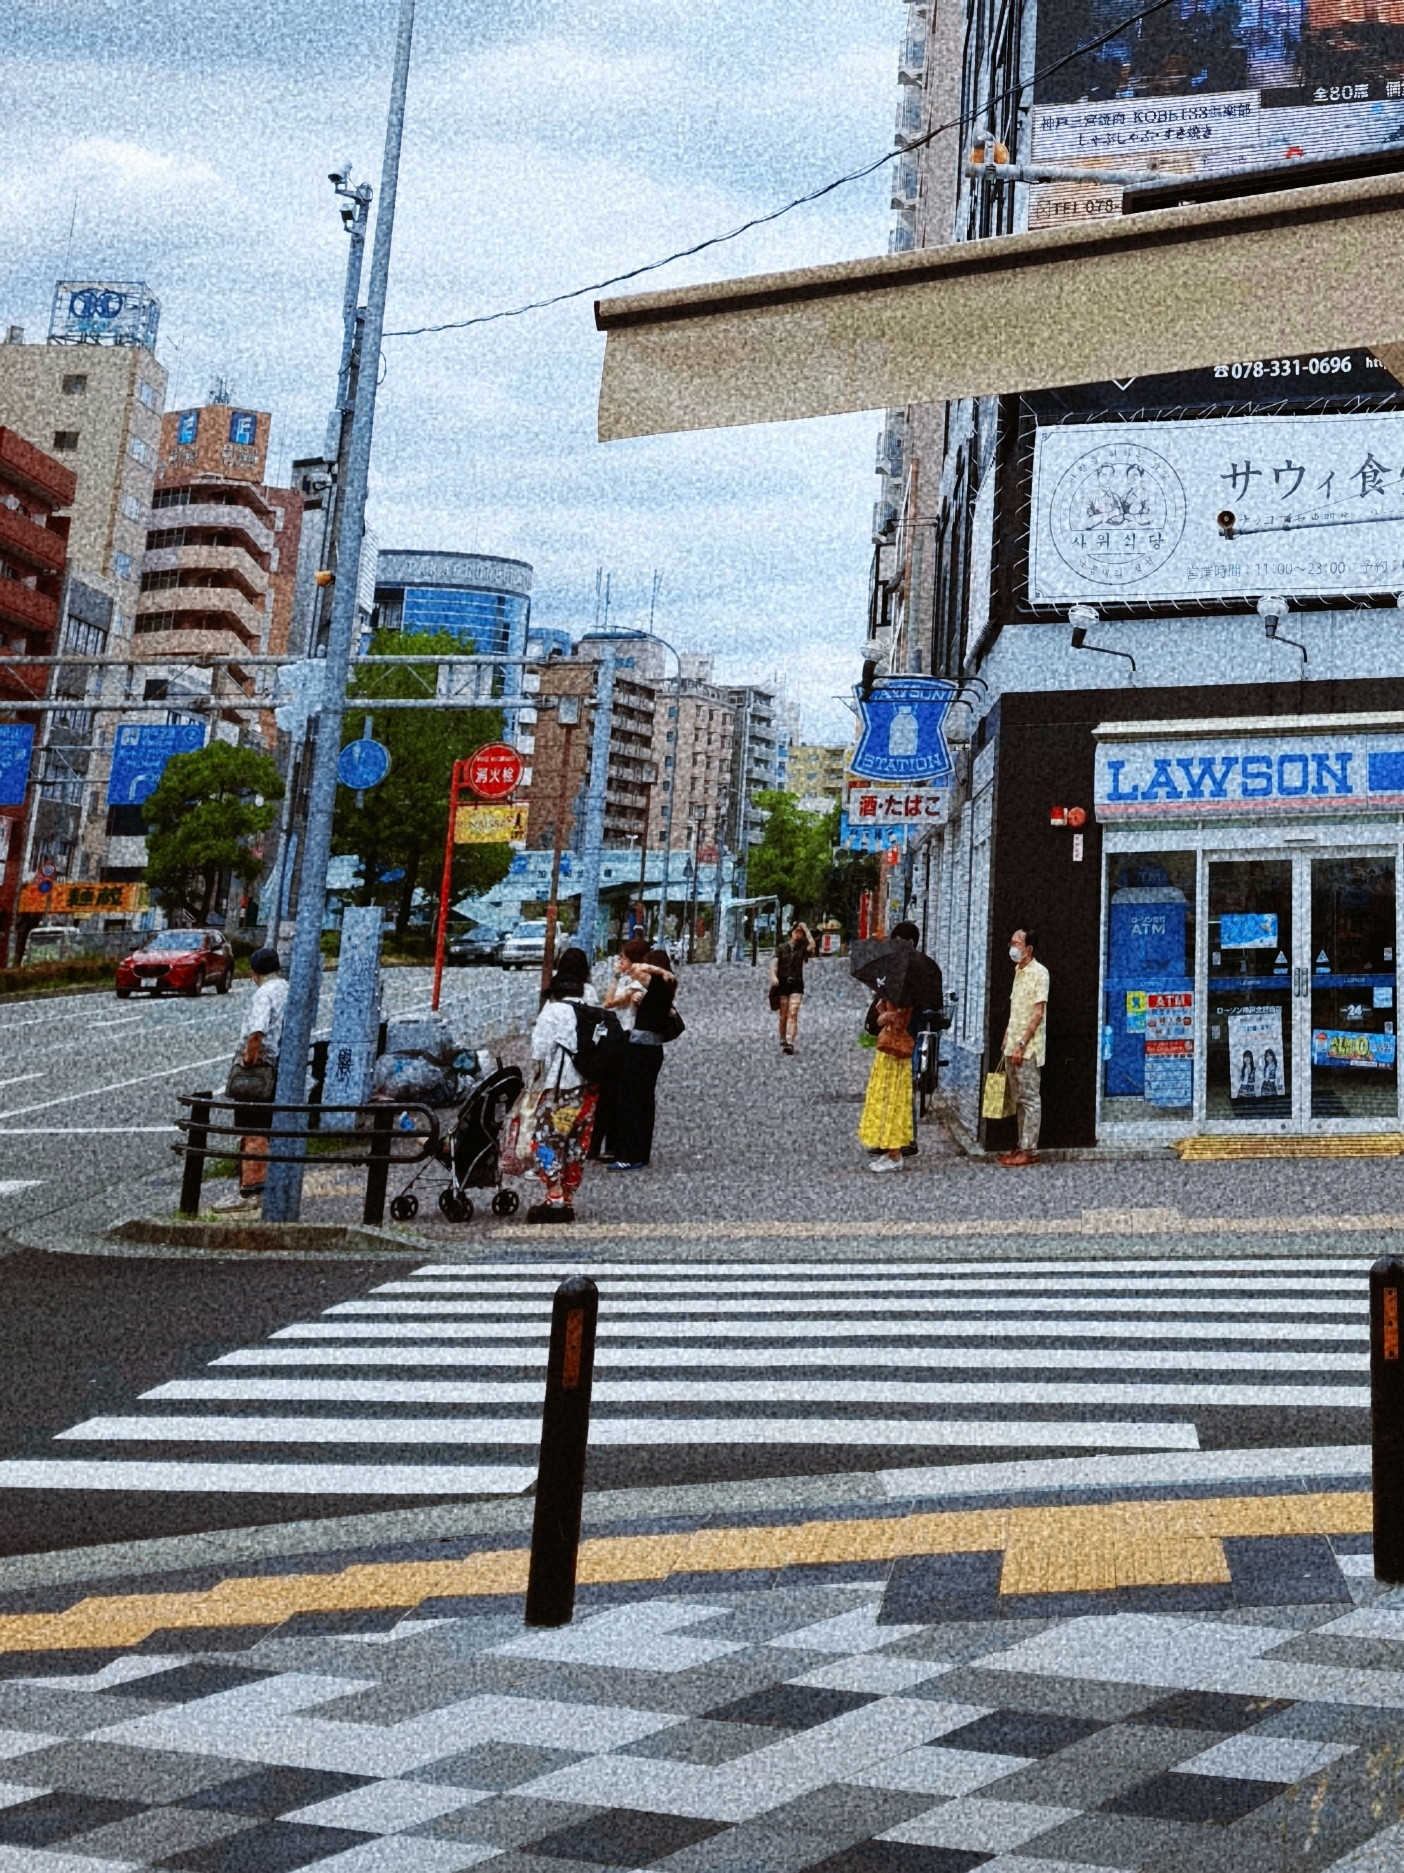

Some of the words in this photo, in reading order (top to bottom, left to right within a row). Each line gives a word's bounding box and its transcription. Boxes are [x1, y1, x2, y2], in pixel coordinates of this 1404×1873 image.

[1231, 356, 1352, 379] 078-331-0696
[870, 684, 946, 700] AWSON
[862, 753, 943, 772] STATION
[475, 767, 515, 784] 消火栓
[1106, 751, 1354, 802] LAWSON
[1130, 923, 1166, 936] ATM
[1156, 994, 1186, 1007] ATM
[1347, 1004, 1363, 1016] 24
